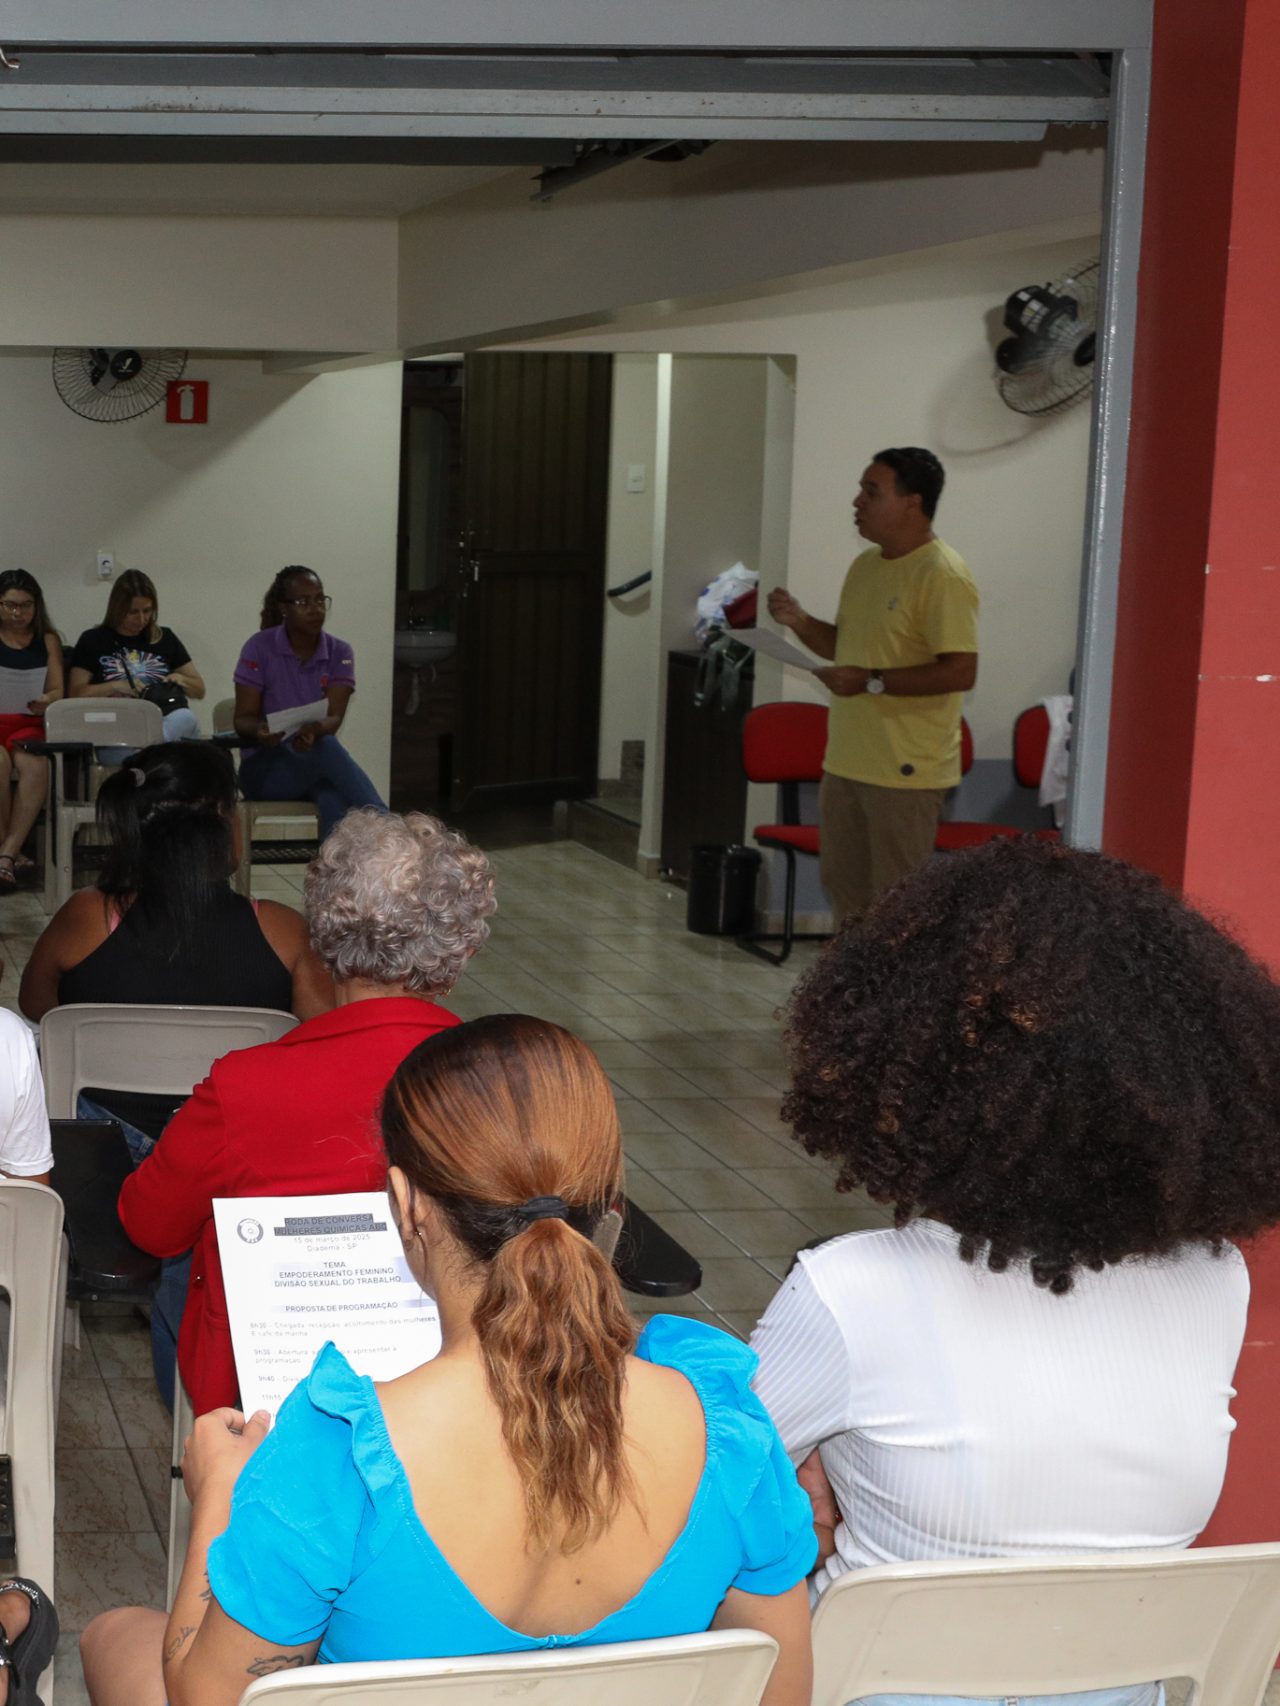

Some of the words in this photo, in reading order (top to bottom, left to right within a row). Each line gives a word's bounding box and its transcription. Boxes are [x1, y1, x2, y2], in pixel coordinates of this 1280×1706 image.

[284, 1217, 310, 1227] RODA
[311, 1217, 324, 1225] DE
[325, 1214, 374, 1224] CONVERSA
[279, 1269, 353, 1279] EMPODERAMENTO
[355, 1267, 394, 1276] FEMININO
[308, 1278, 341, 1287] SEXUAL
[342, 1278, 355, 1286] DO
[356, 1275, 401, 1285] TRABALHO
[285, 1304, 326, 1313] PROPOSTA
[326, 1304, 337, 1312] DE
